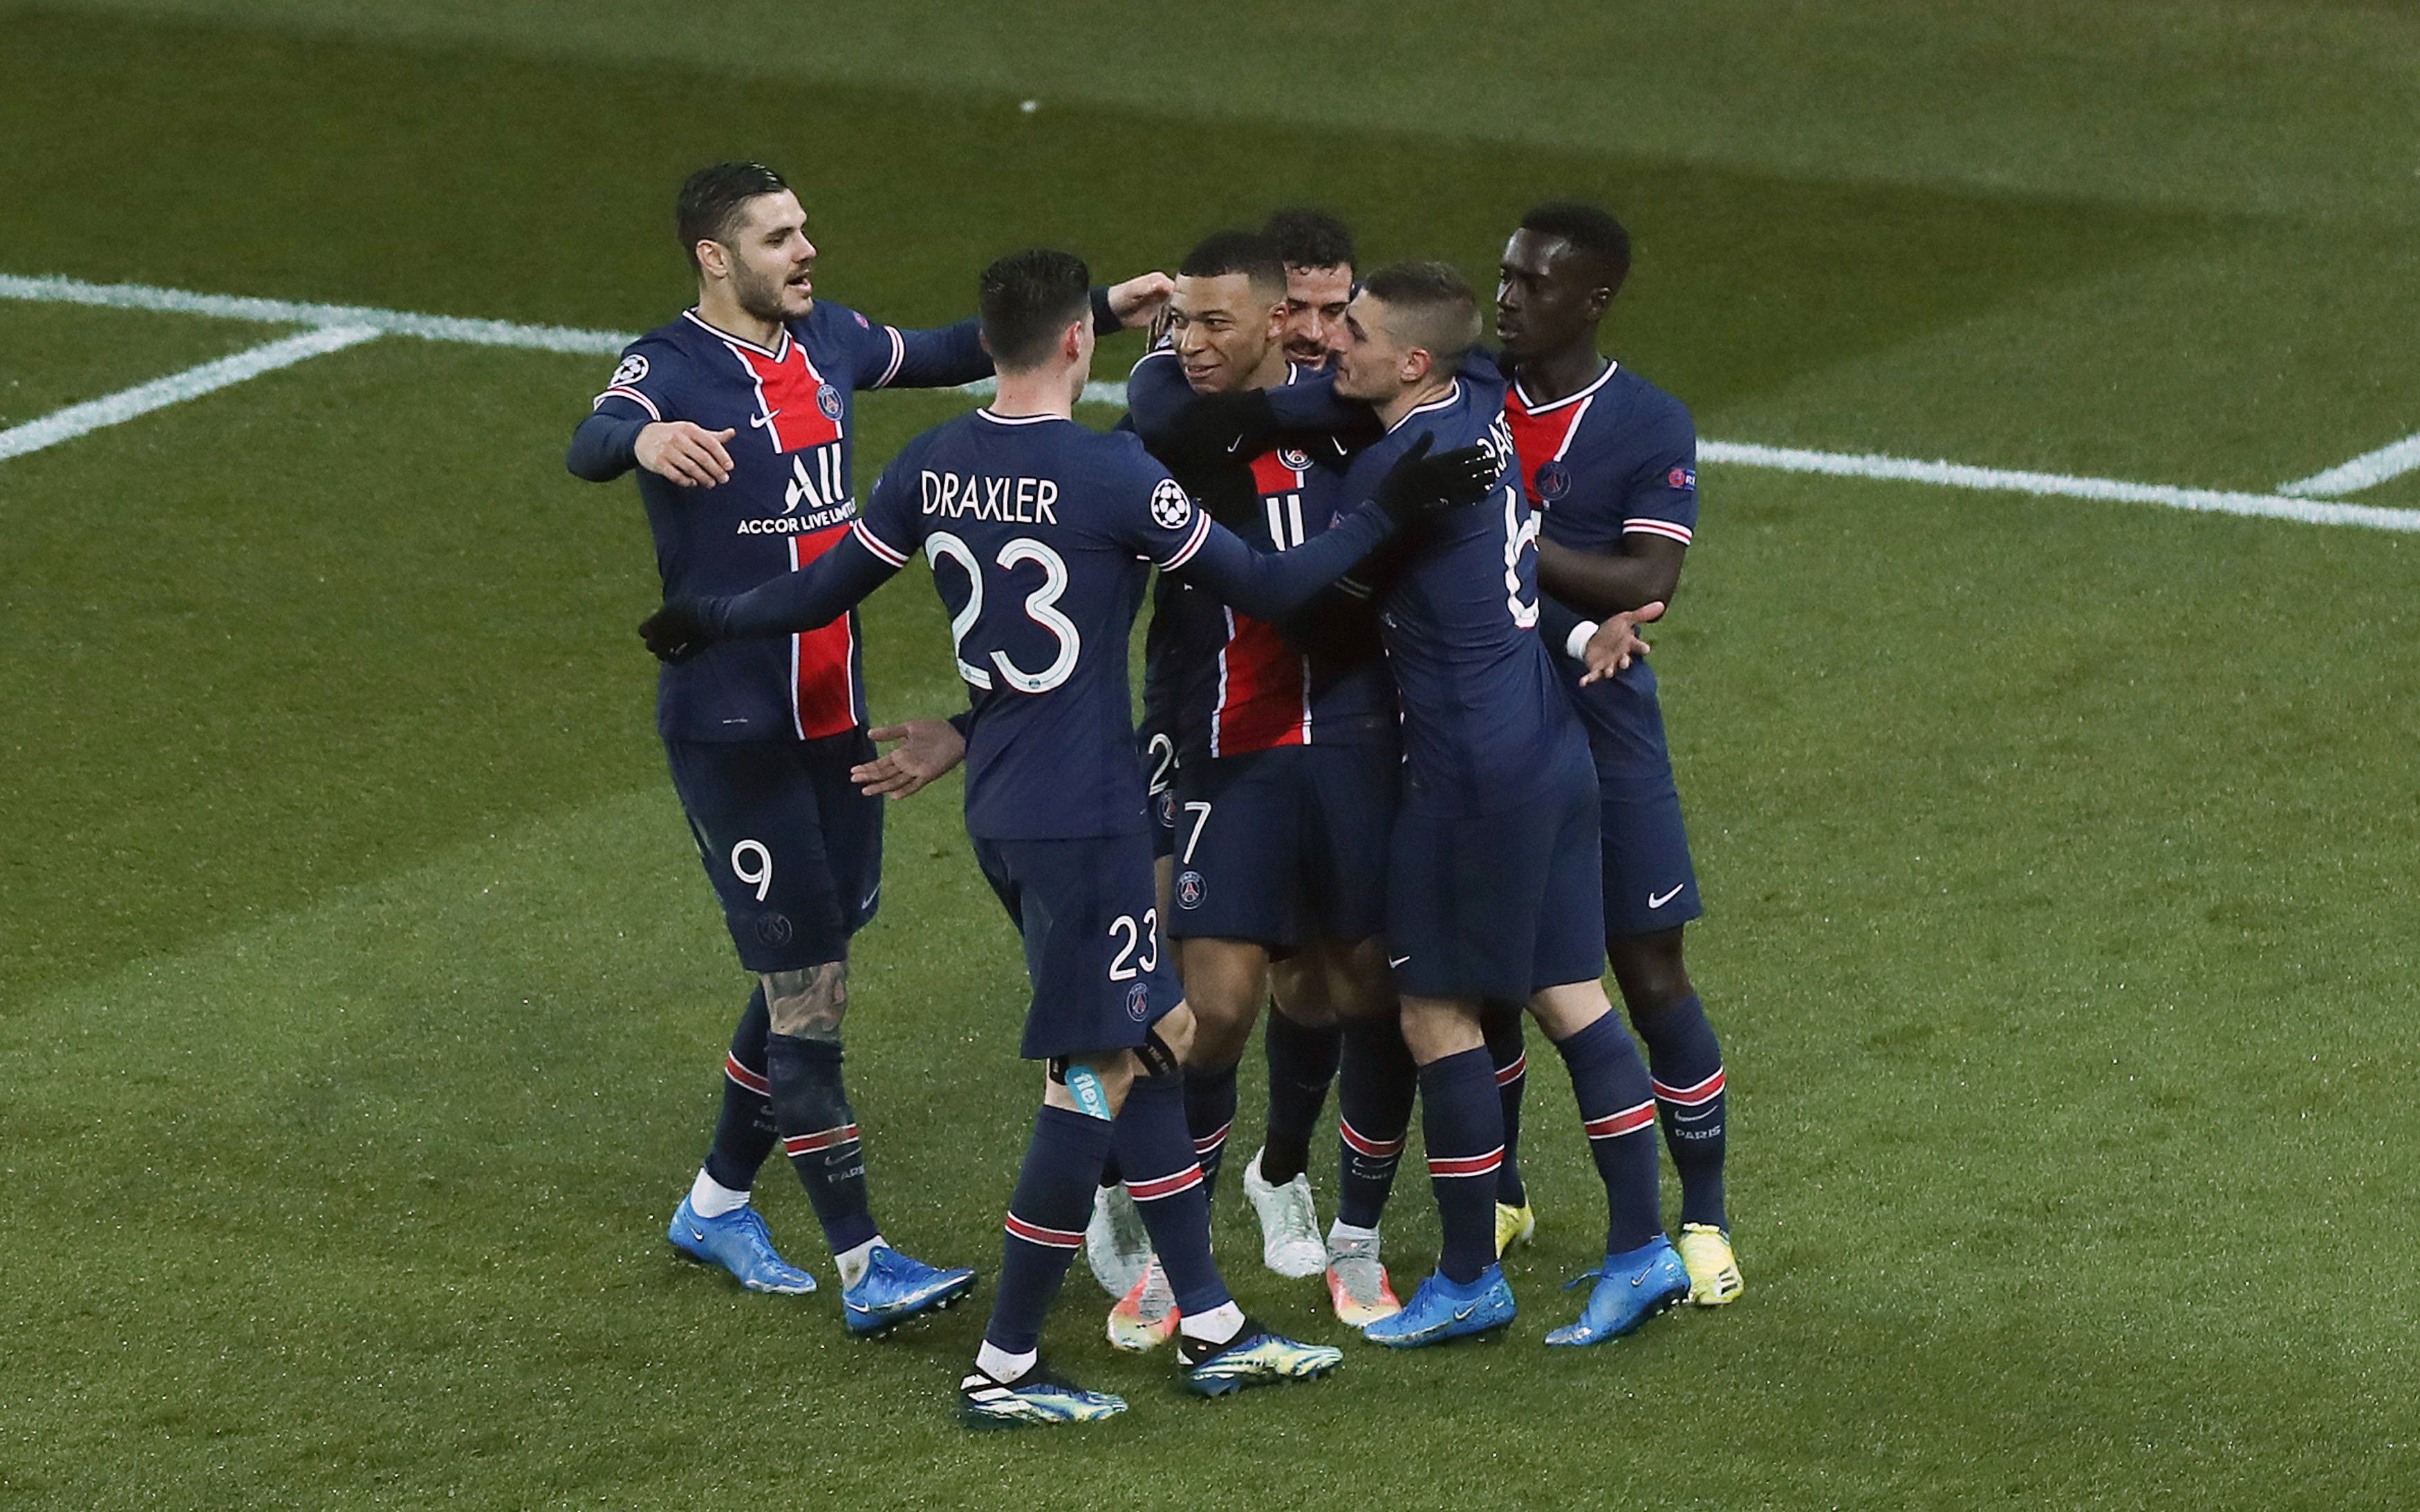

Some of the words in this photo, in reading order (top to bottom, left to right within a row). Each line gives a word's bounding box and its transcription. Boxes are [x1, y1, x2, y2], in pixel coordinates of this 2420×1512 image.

[781, 442, 844, 514] All
[921, 470, 1059, 525] DRAXLER
[737, 518, 799, 534] ACCOR
[801, 510, 830, 530] LIVE
[924, 531, 1081, 693] 23
[1184, 801, 1212, 865] 7
[731, 839, 772, 902] 9
[1108, 907, 1157, 981] 23
[1073, 1072, 1105, 1119] flex
[1675, 1125, 1721, 1140] PARIS
